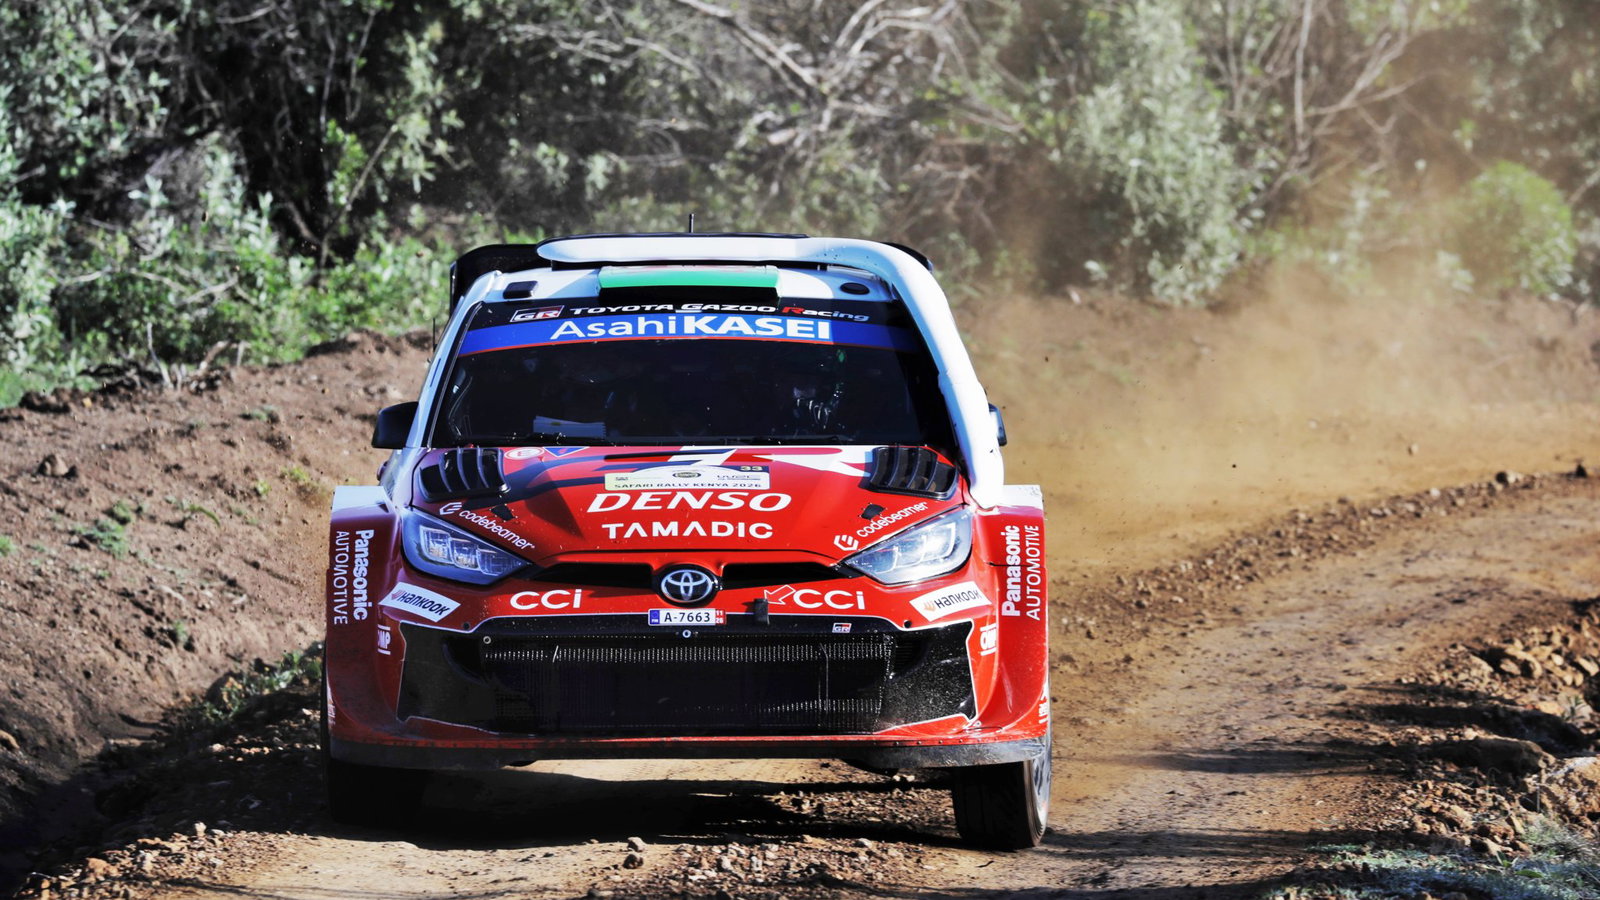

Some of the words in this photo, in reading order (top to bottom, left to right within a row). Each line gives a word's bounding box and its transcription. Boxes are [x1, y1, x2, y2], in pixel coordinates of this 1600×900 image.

[513, 309, 559, 321] GR
[569, 303, 674, 315] TOYOTA
[679, 302, 776, 313] GAZOO
[781, 306, 870, 321] Racing
[586, 491, 792, 513] DENSO
[856, 501, 929, 537] codebeamer
[458, 510, 534, 550] codebeamer
[601, 521, 773, 539] TAMADIC
[353, 529, 375, 621] Panasonic
[1001, 525, 1022, 617] Panasonic
[1024, 524, 1041, 621] AUTOMOTIVE
[664, 611, 711, 623] A-7663
